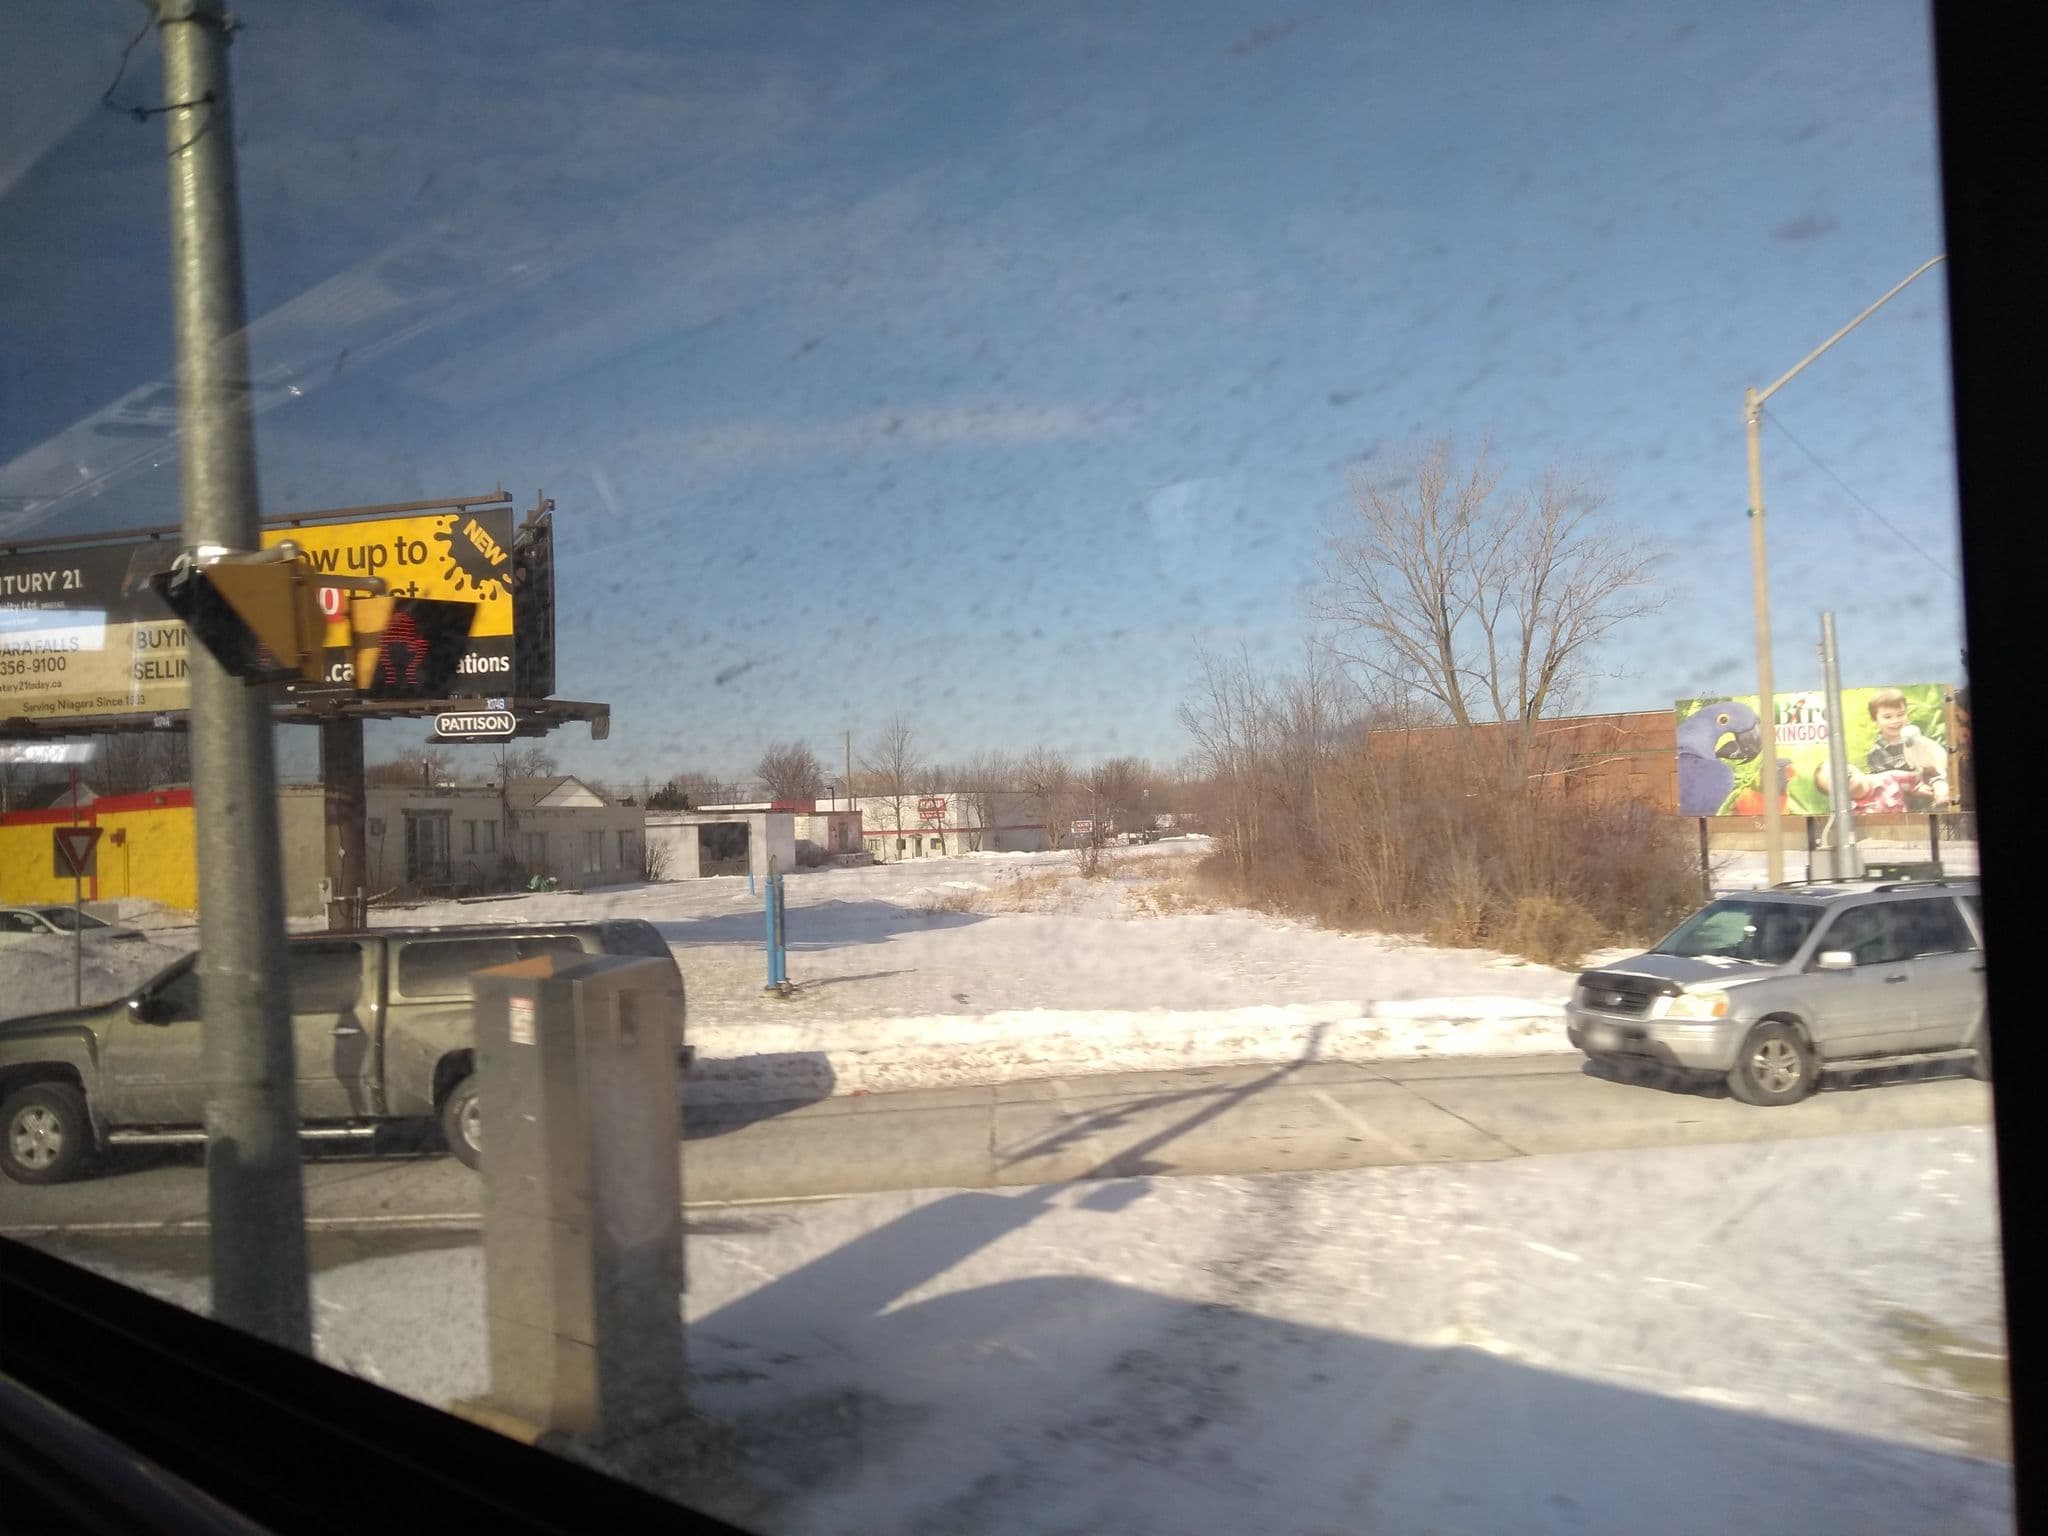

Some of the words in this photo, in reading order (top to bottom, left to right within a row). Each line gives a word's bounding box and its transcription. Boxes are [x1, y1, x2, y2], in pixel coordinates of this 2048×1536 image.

[463, 518, 508, 565] NEW
[347, 543, 387, 575] up
[394, 536, 428, 566] to
[0, 571, 57, 595] TURY
[62, 569, 81, 590] 21
[0, 641, 33, 657] ARA
[0, 656, 66, 676] 356-9100
[456, 653, 510, 673] ations
[0, 680, 62, 693] tury21today.ca
[23, 702, 55, 713] Serving
[57, 698, 94, 711] Niagara
[96, 697, 123, 708] Since
[441, 716, 509, 731] PATTISON
